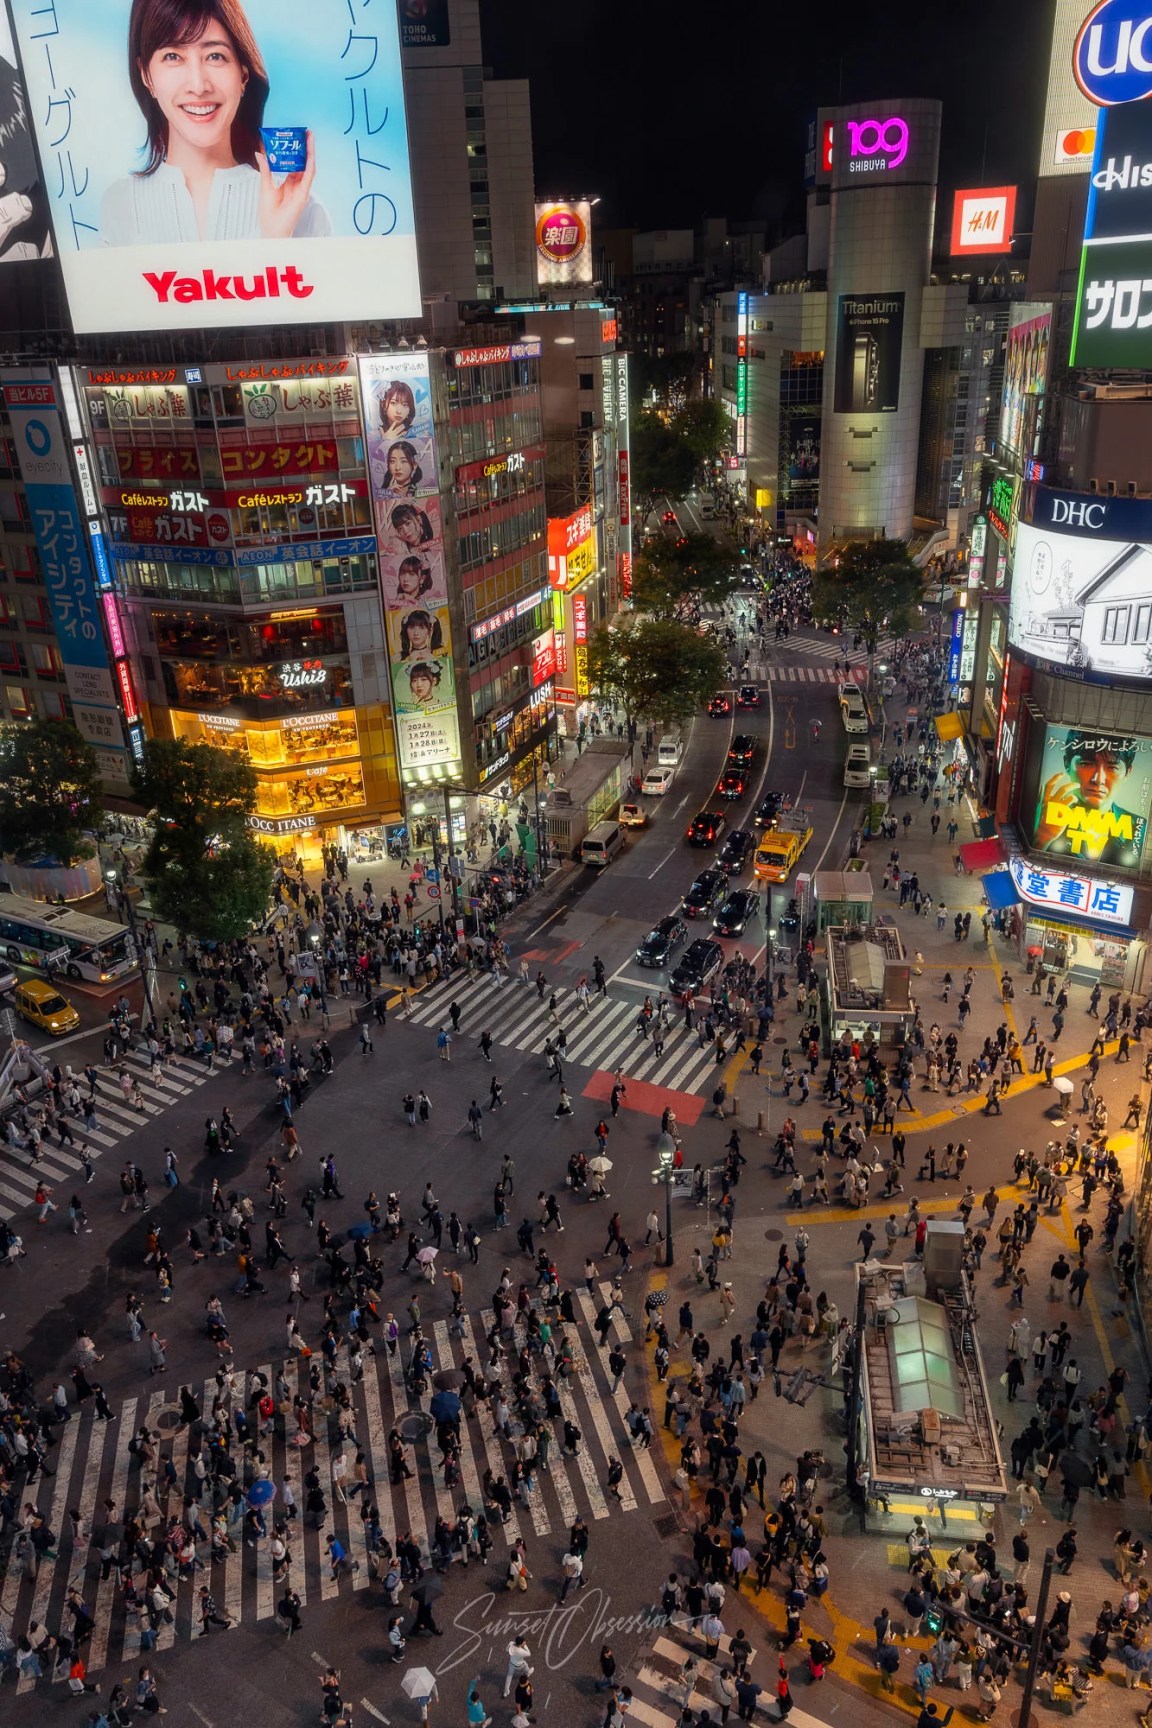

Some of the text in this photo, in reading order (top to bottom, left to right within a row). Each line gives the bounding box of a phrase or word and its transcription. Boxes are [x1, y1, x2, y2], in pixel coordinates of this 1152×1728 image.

[402, 25, 427, 34] TOHO
[403, 34, 437, 43] CINEMAS
[270, 140, 302, 150] ソフール
[847, 117, 909, 169] 109
[849, 159, 886, 173] SHIBUYA
[967, 210, 1000, 233] H&M
[545, 226, 579, 246] 楽園
[142, 266, 314, 304] Yakult
[842, 300, 899, 315] Titanium
[88, 369, 177, 385] しゃぶしゃぶバイキング
[226, 360, 349, 381] しゃぶしゃぶバイキング
[282, 383, 354, 411] しゃぶ葉
[617, 358, 628, 422] BIC CAMERA
[89, 401, 105, 415] 9F
[134, 394, 187, 417] しゃぶ葉
[222, 443, 335, 473] コンタクト
[507, 452, 526, 473] ガスト
[169, 490, 209, 512] ガスト
[238, 483, 356, 508] Caféレストラン ガスト
[1051, 498, 1106, 529] DHC
[155, 516, 202, 541] ガスト
[282, 540, 374, 560] 英会話イーオン
[58, 510, 97, 640] コンタクトの
[280, 669, 327, 688] Ushi8
[1054, 663, 1085, 680] Channel
[530, 681, 552, 708] LUSH
[282, 713, 338, 728] L'OCCITANE
[1047, 736, 1152, 753] ケンシロウによろし
[1046, 801, 1133, 840] DMM
[1066, 829, 1109, 857] TV
